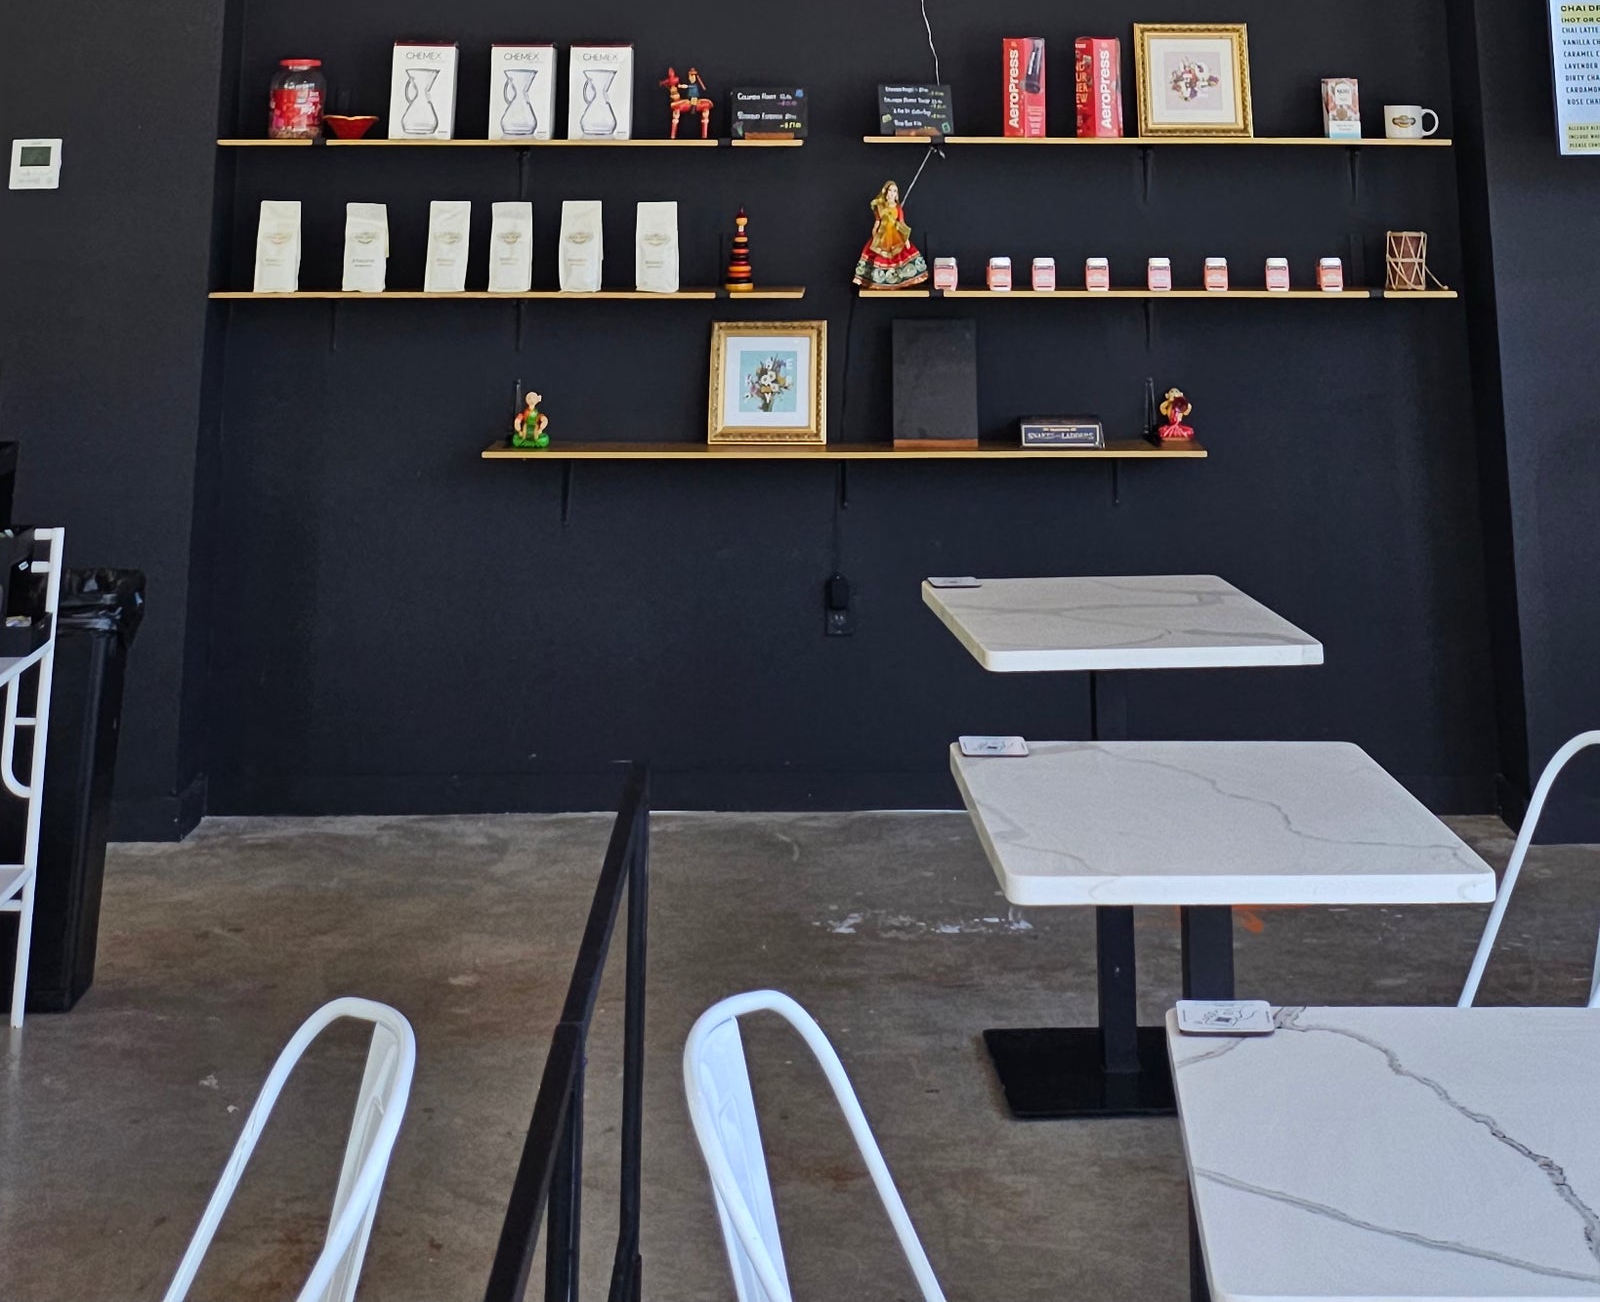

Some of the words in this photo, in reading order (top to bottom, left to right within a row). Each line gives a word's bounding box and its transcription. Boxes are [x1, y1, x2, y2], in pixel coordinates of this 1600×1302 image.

[406, 51, 442, 61] CHEMEX
[504, 51, 539, 61] CHEMEX
[582, 52, 618, 62] CHEMEX
[1009, 49, 1020, 129] AeroPress
[1100, 50, 1112, 129] AeroPress
